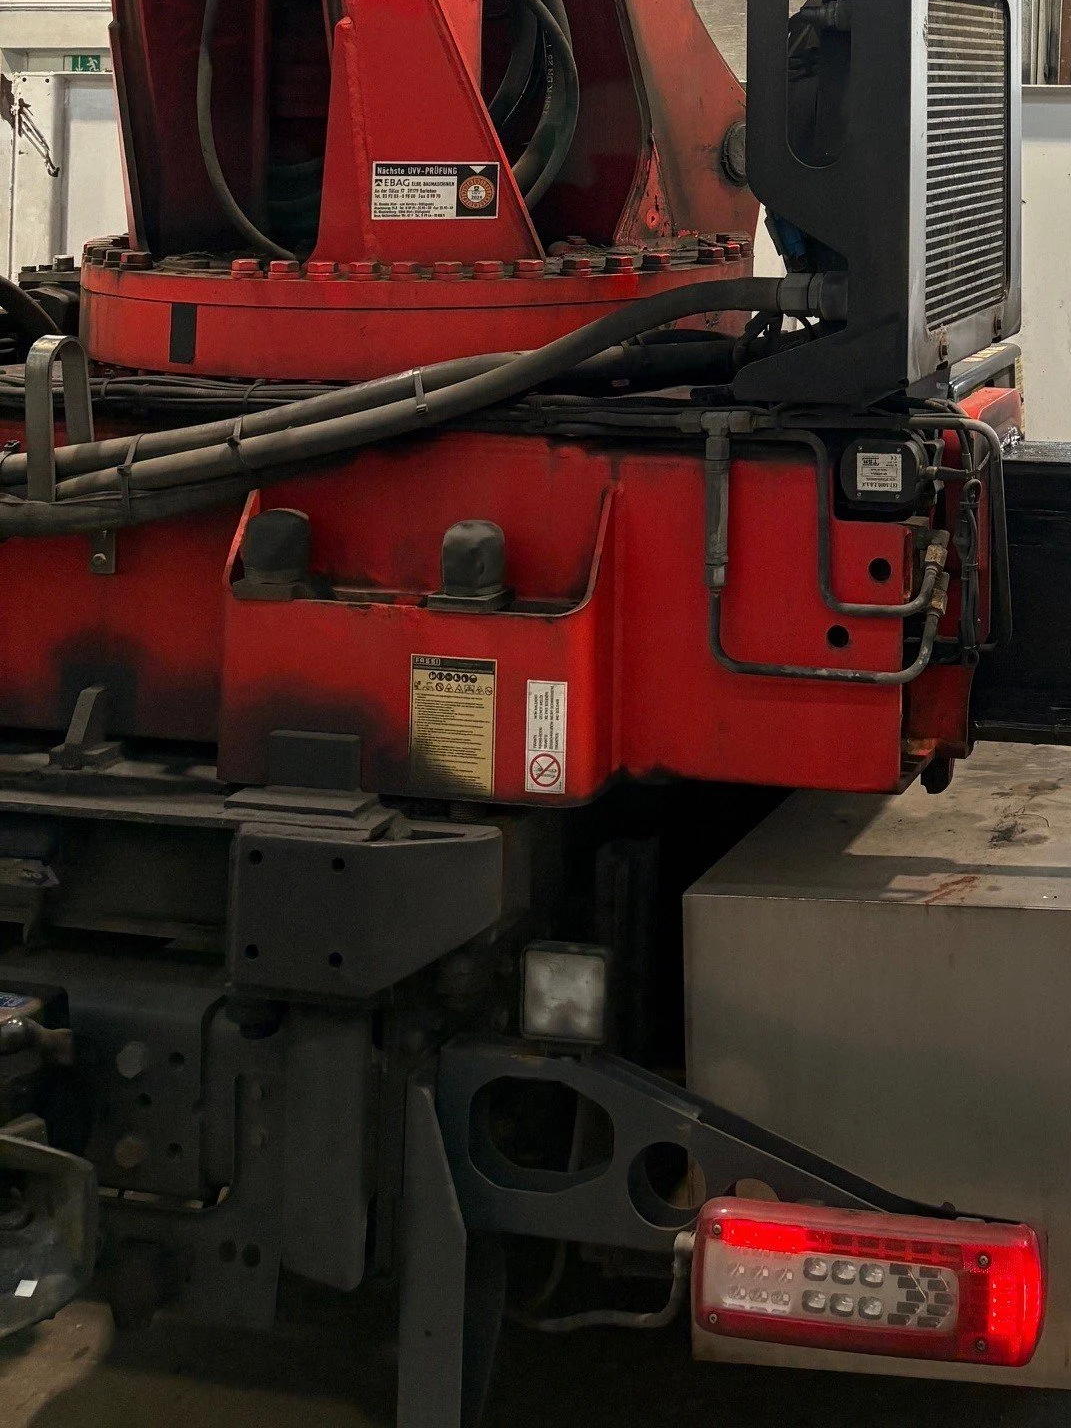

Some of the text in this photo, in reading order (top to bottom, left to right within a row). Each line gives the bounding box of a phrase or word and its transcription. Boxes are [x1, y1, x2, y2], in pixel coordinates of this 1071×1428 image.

[377, 165, 458, 175] Nächste UVV-PRÜFUNG
[384, 178, 411, 187] EBAG
